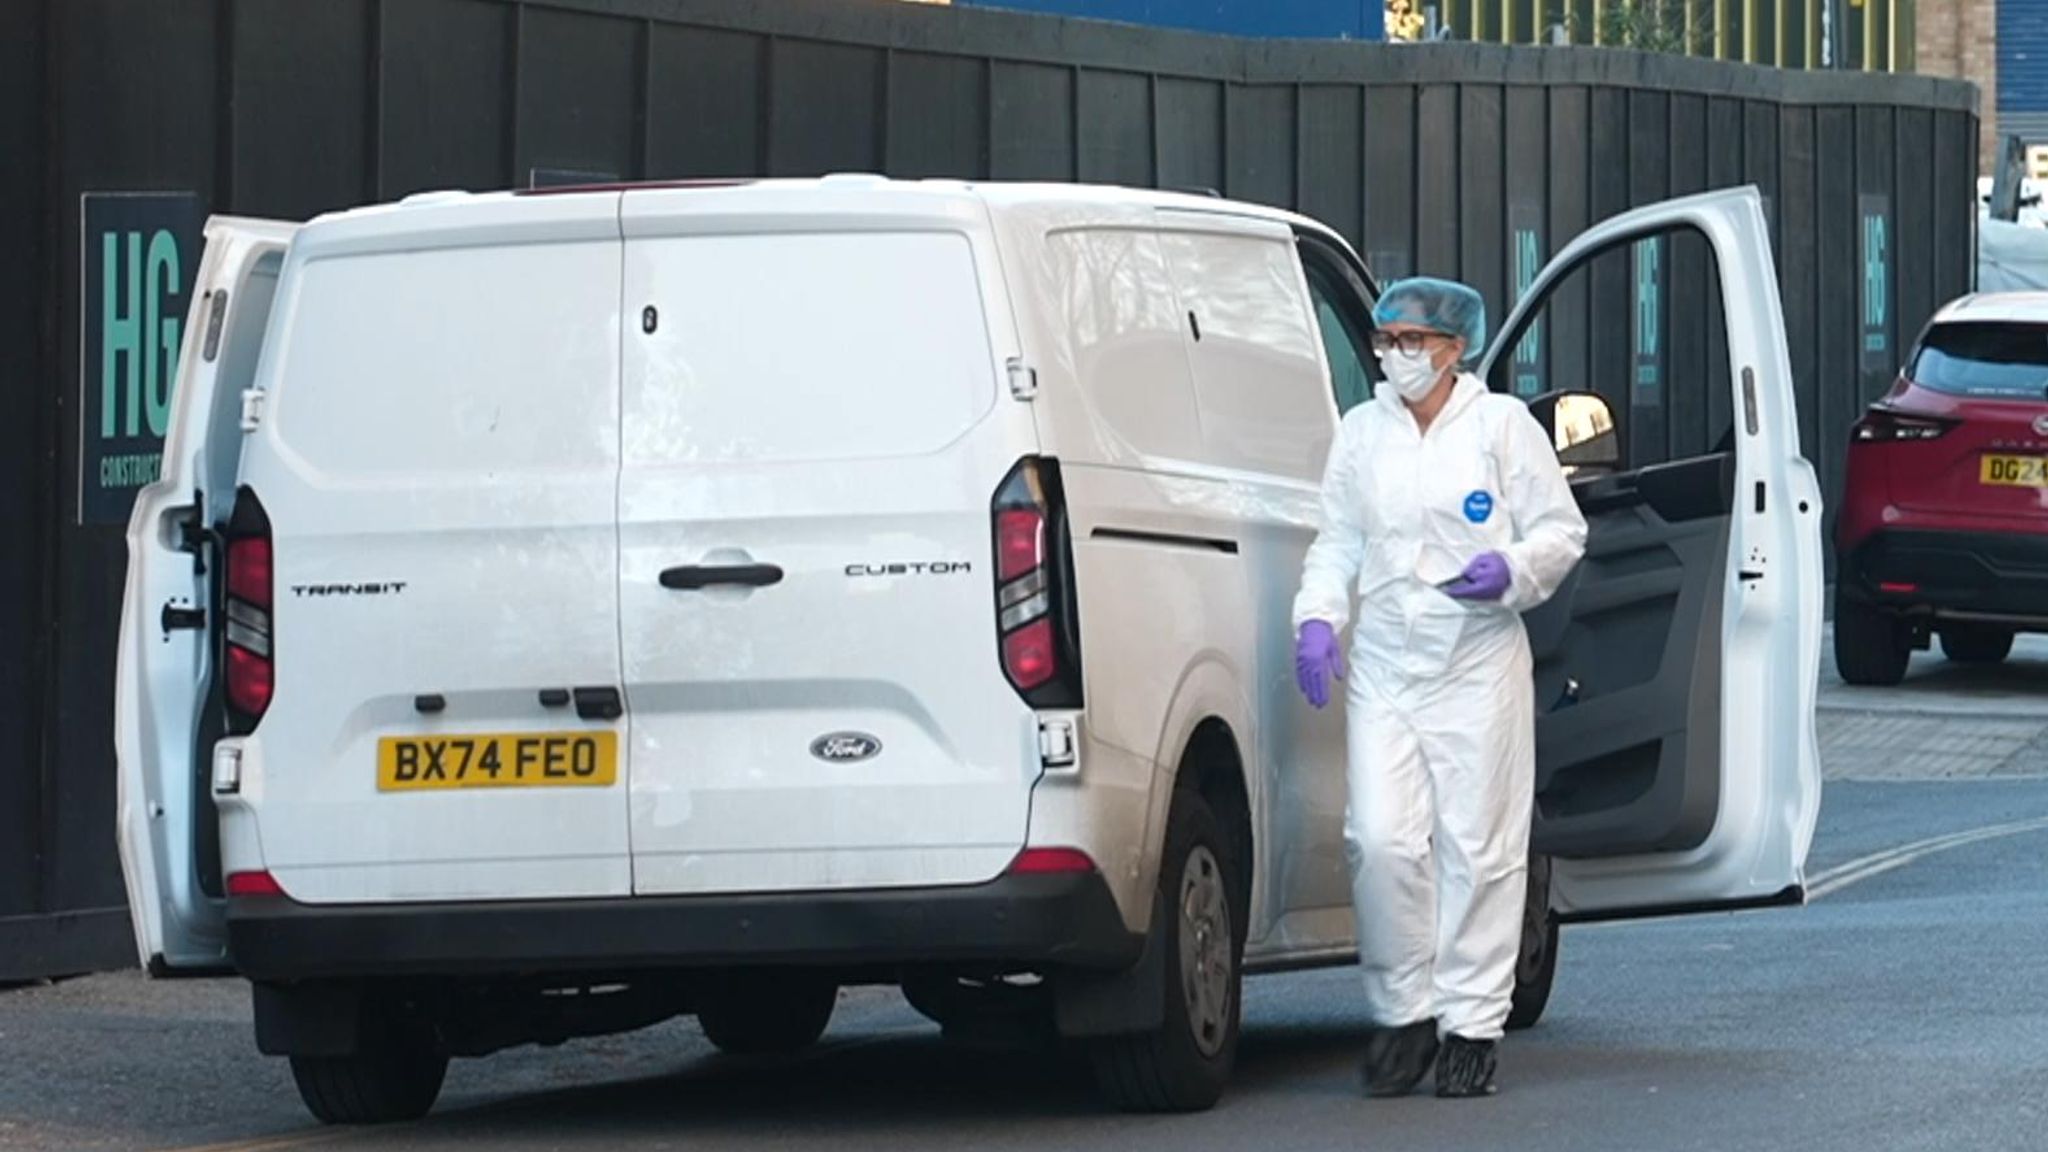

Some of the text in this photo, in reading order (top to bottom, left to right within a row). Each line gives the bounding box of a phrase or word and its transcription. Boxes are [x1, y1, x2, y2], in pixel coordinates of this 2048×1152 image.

[101, 228, 180, 438] HG
[844, 561, 972, 577] CUSTOM
[291, 582, 407, 597] TRANSIT
[823, 738, 867, 757] Ford
[394, 737, 597, 782] BX74 FEO
